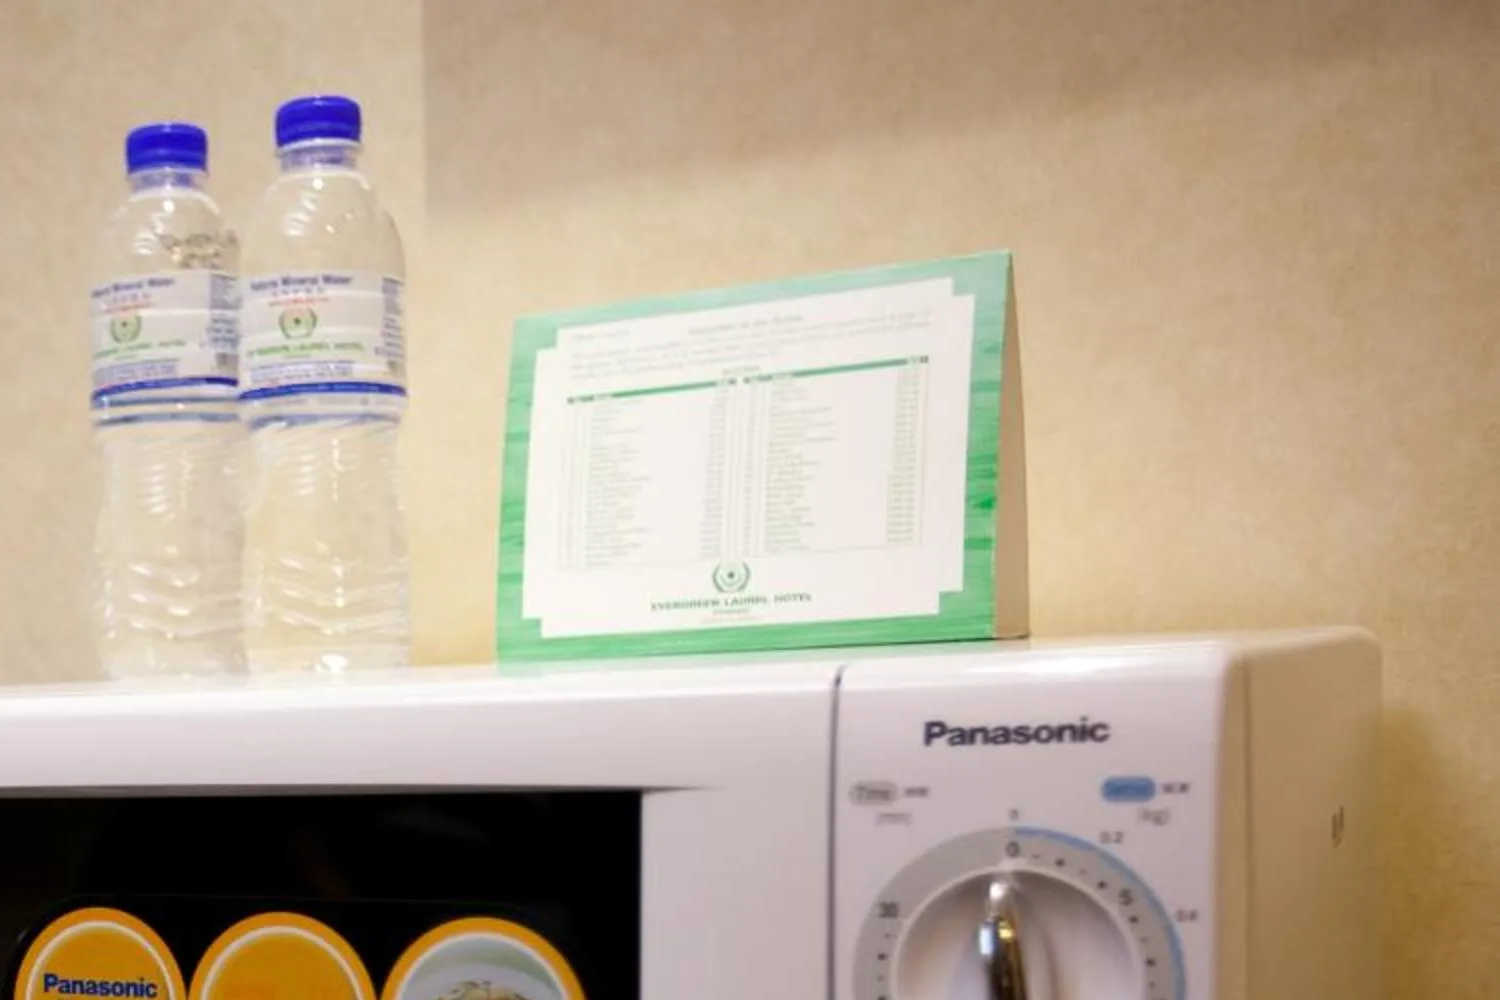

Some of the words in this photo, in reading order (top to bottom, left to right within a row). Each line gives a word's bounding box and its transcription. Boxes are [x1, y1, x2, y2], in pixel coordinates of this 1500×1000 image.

[774, 592, 812, 603] HOTEL
[924, 716, 1111, 746] Panasonic
[1006, 841, 1020, 858] 0
[43, 973, 158, 999] Panasonic
